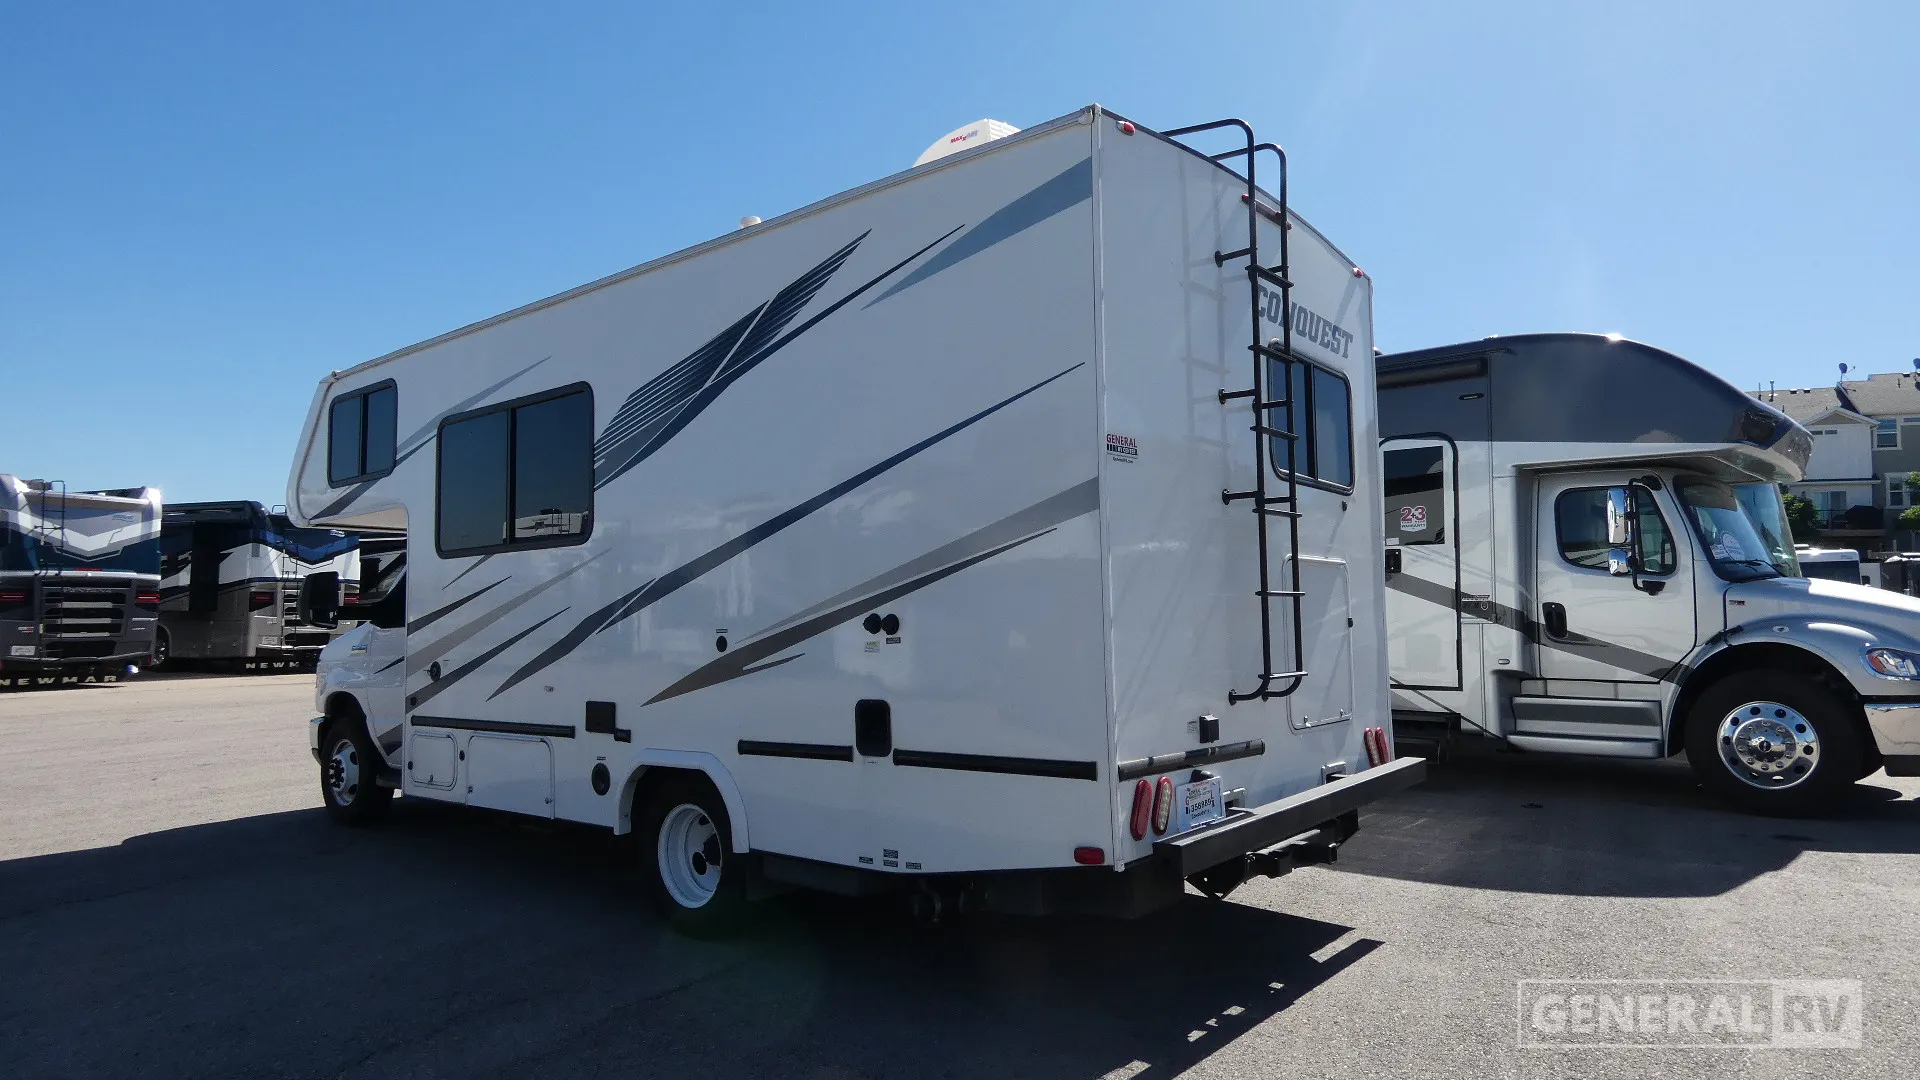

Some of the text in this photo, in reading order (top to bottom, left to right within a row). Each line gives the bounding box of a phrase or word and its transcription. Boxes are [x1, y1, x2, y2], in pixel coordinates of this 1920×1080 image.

[1256, 283, 1354, 359] CONQUEST
[1106, 433, 1138, 448] GENERAL
[0, 675, 117, 686] NEWMAR
